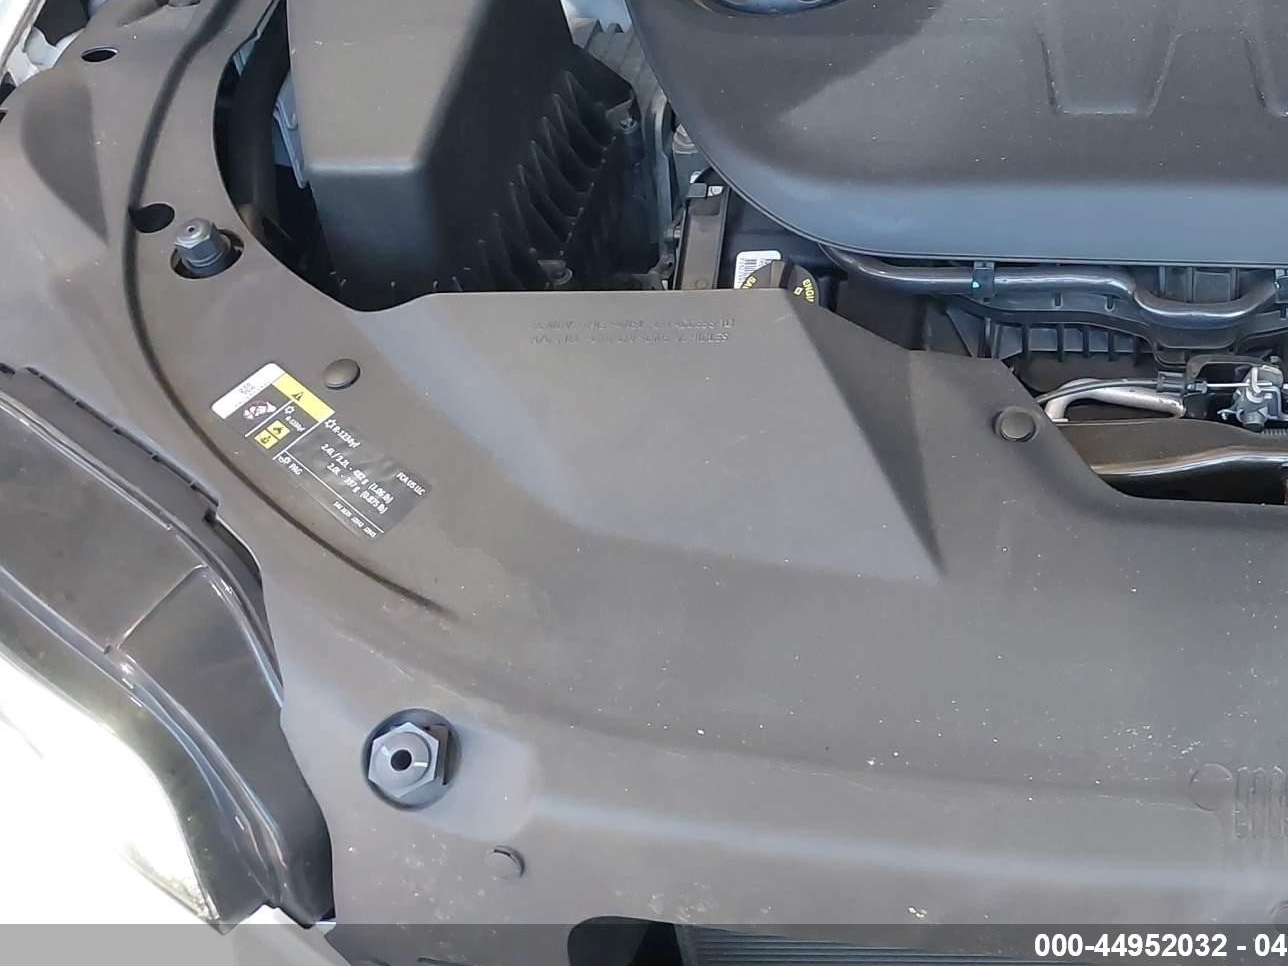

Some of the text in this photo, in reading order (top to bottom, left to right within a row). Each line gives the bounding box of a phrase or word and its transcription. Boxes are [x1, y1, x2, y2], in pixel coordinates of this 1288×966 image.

[332, 425, 360, 448] R-1234yf
[289, 463, 303, 474] PAG
[396, 472, 425, 495] FCA US LLC
